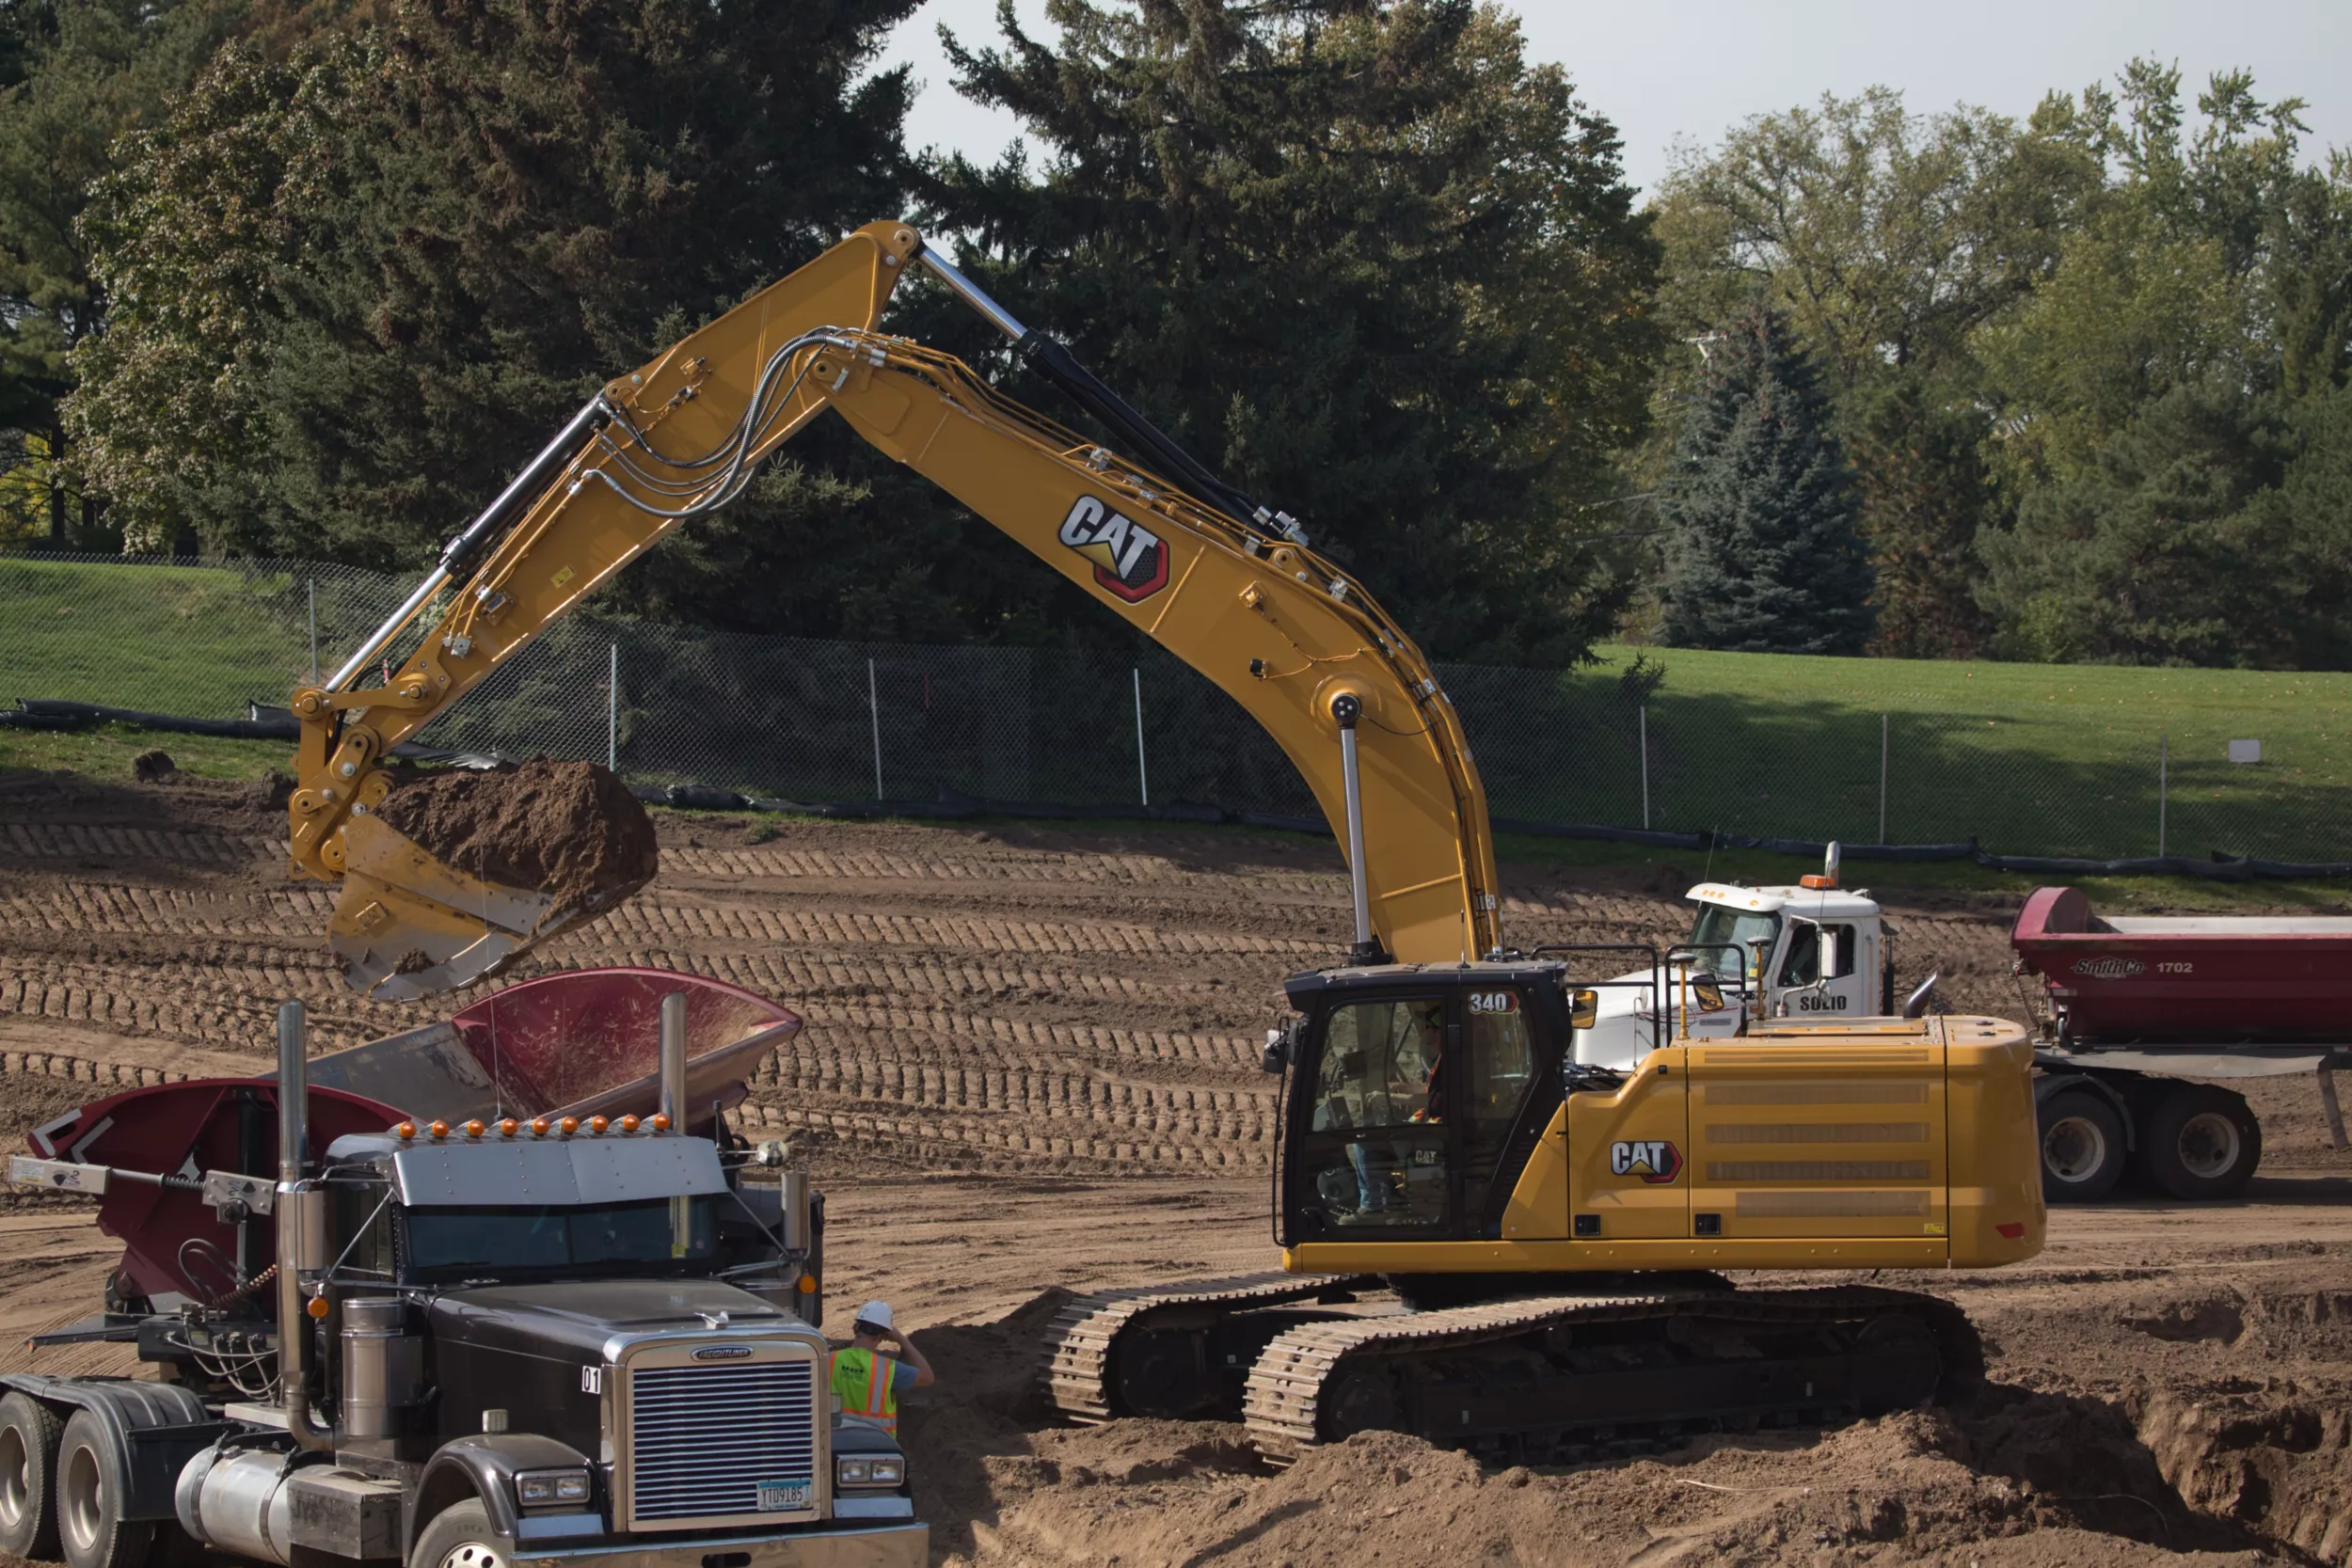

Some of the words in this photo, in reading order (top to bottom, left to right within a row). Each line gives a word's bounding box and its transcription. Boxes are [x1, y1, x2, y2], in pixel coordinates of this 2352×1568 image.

[1060, 496, 1159, 580] CAT
[2075, 959, 2144, 974] SmithCo
[2157, 962, 2193, 974] 1702
[1470, 993, 1507, 1012] 340
[1800, 995, 1847, 1011] SOLID
[1415, 1150, 1438, 1164] CAT
[1612, 1142, 1665, 1175] CAT
[698, 1348, 749, 1359] FREIGHTLINER
[584, 1367, 599, 1393] 01
